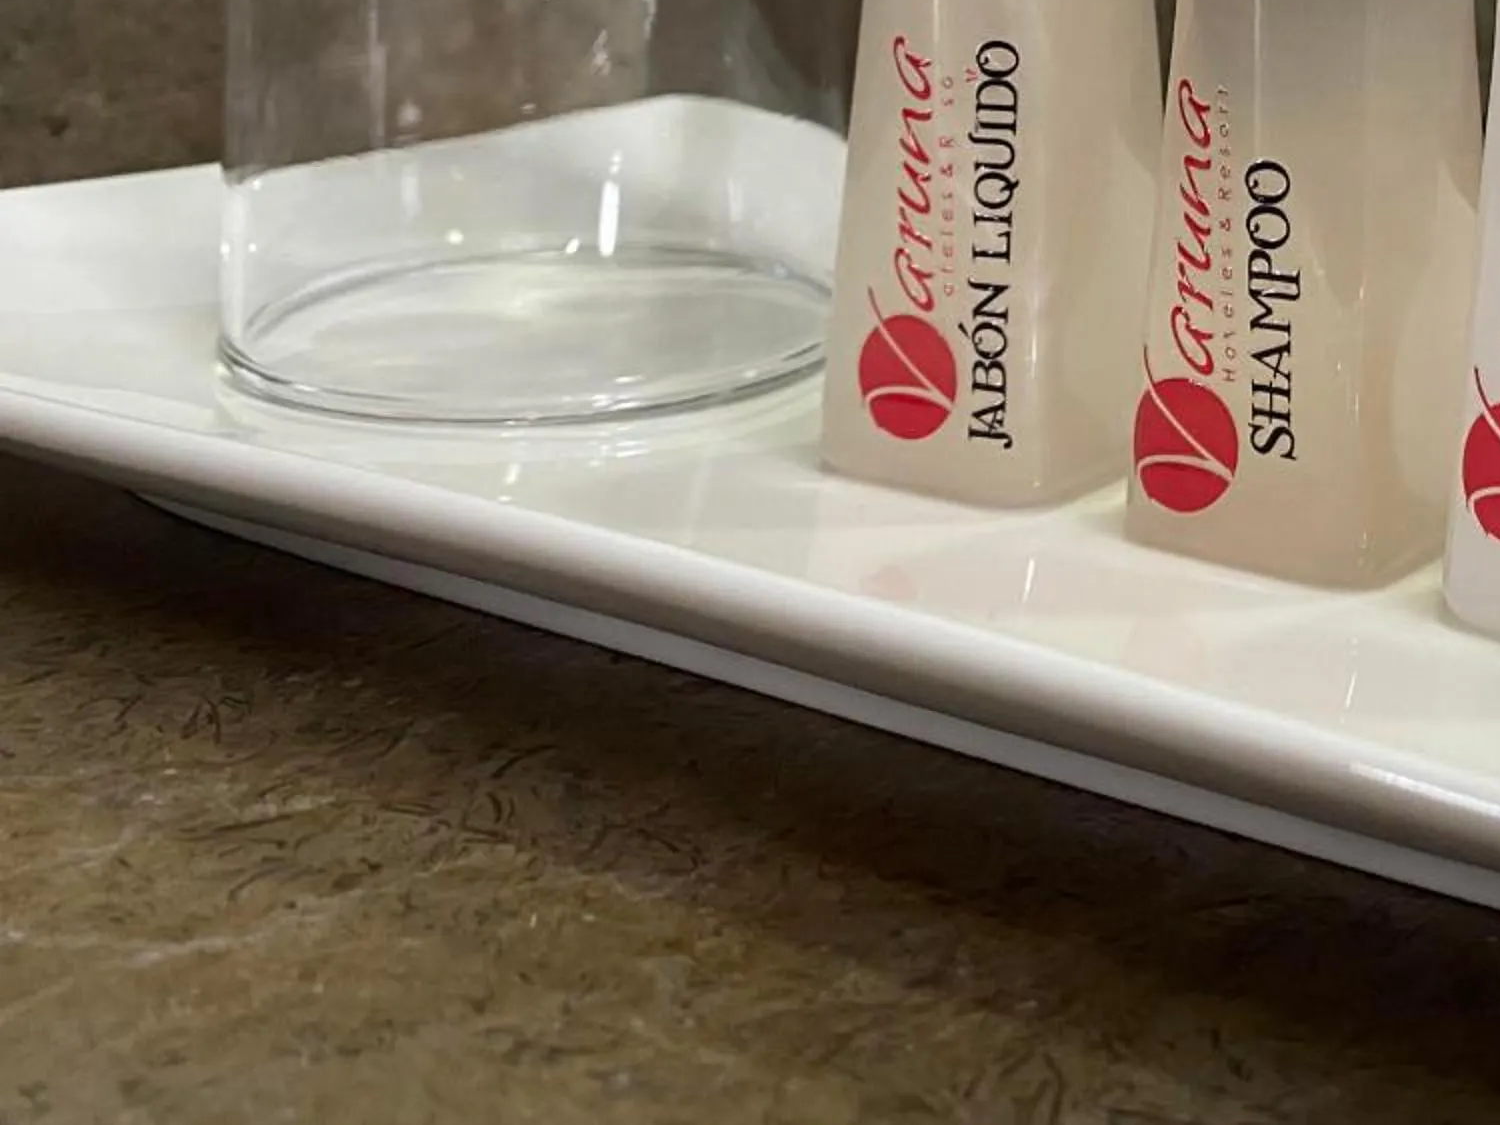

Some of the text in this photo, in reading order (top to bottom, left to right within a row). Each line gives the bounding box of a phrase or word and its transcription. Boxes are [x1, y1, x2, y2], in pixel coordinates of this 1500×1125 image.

[858, 35, 957, 439] Varuna
[957, 39, 1021, 450] JABÓN LIQUIDO
[1133, 78, 1240, 513] Varuna
[1244, 159, 1300, 461] SHAMPOO
